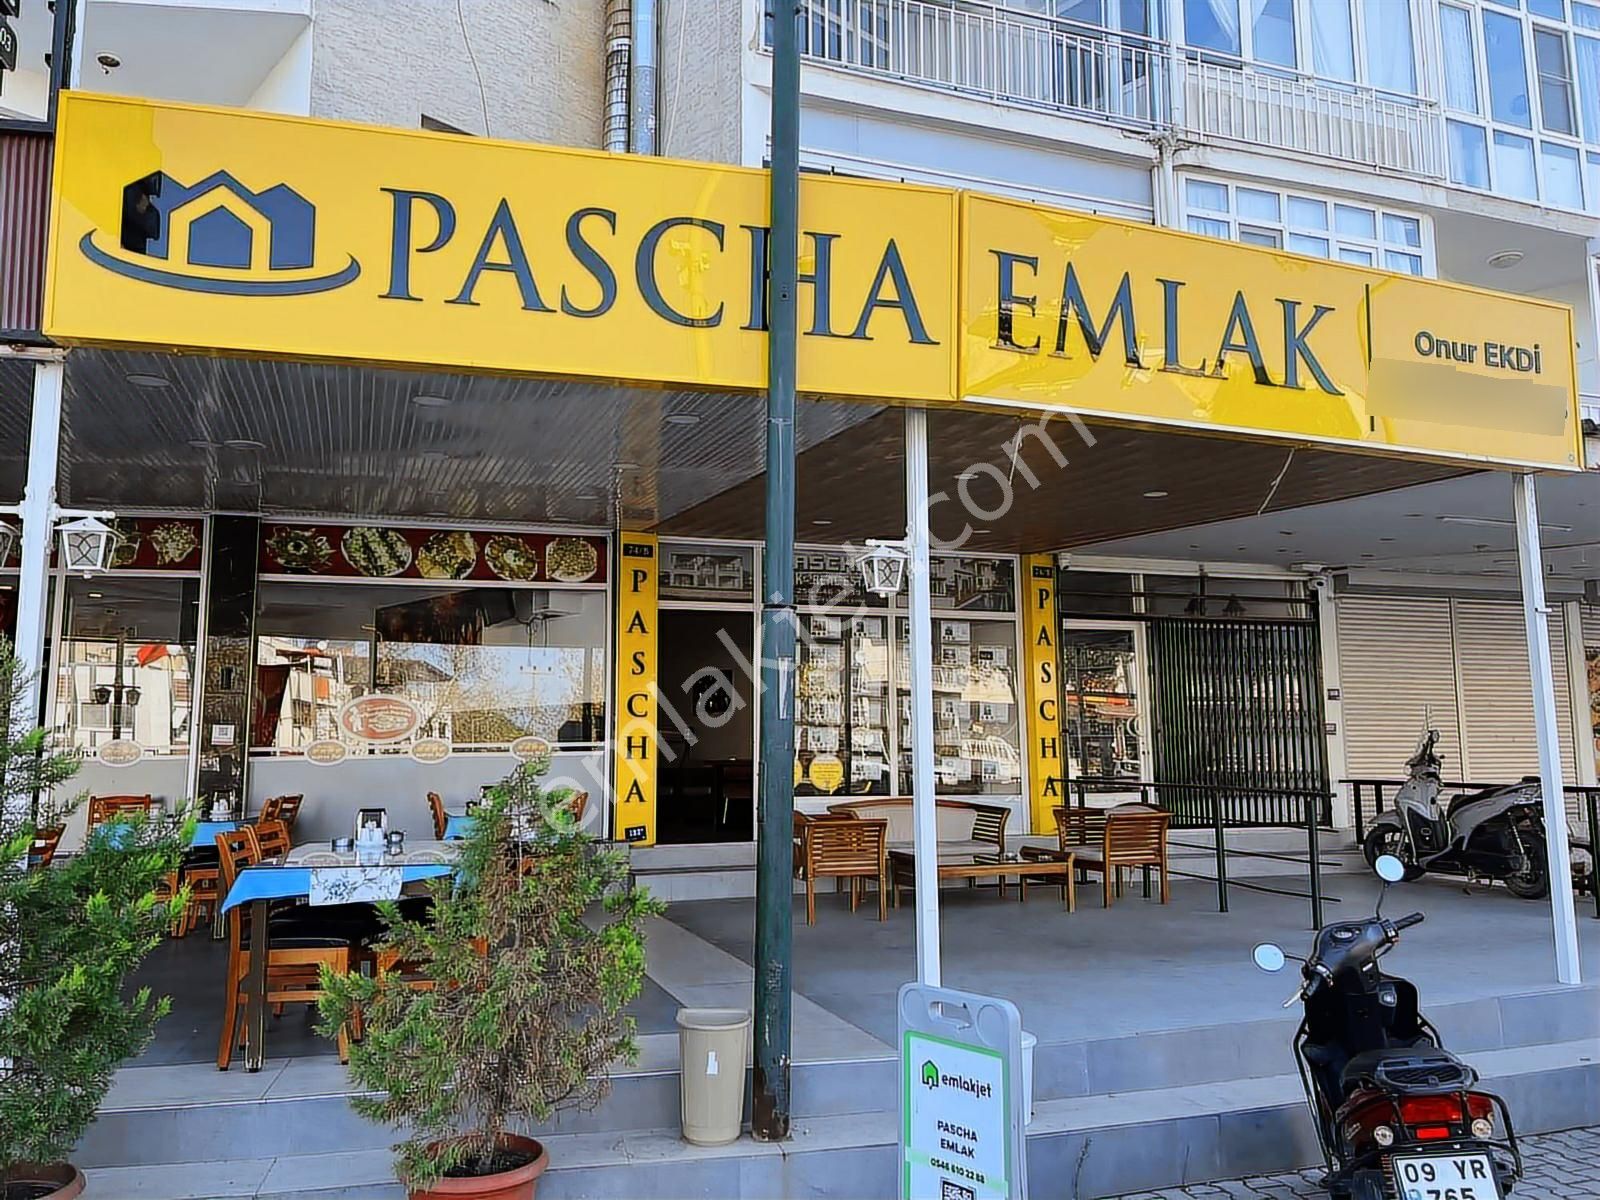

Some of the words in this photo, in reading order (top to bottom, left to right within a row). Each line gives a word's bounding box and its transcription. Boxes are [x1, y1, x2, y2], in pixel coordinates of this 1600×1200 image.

[378, 187, 941, 346] PASCHA
[988, 249, 1346, 397] EMLAK
[1415, 331, 1477, 363] Onur
[623, 569, 649, 804] PASCHA
[1037, 588, 1058, 797] PASCHA
[941, 1074, 992, 1099] emlakjet
[938, 1120, 978, 1142] PASCHA
[940, 1138, 975, 1159] EMLAK
[1404, 1163, 1436, 1183] 09
[1453, 1159, 1487, 1180] YR
